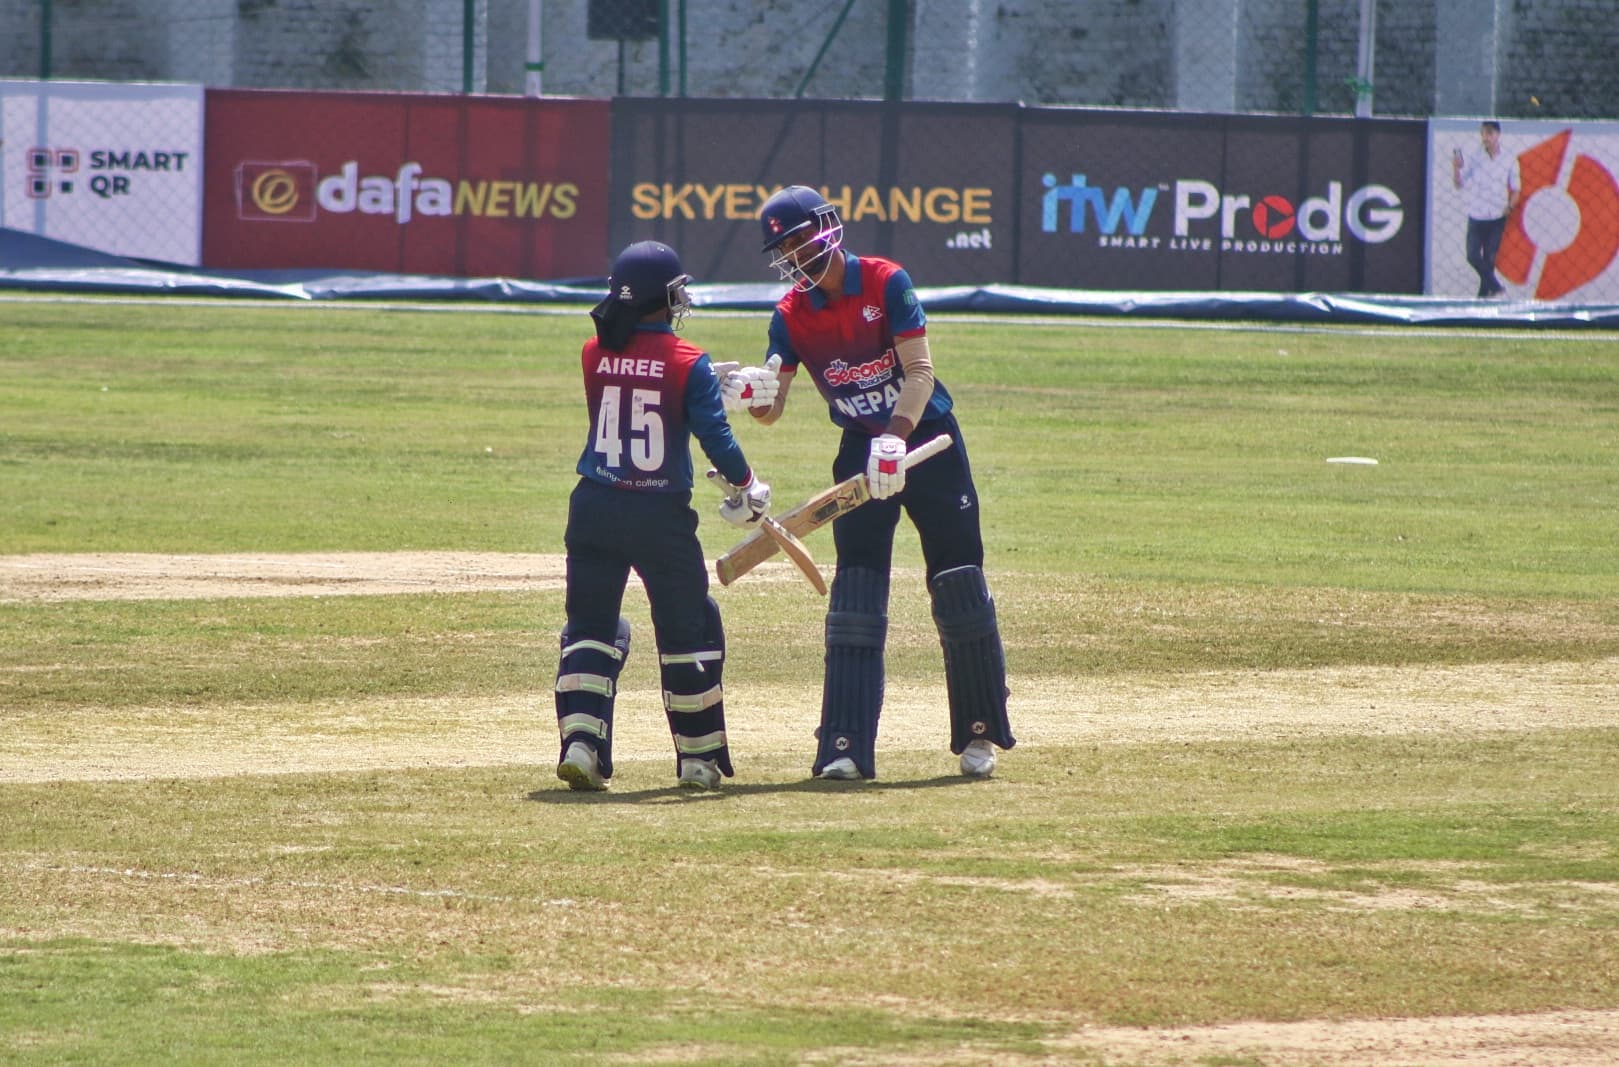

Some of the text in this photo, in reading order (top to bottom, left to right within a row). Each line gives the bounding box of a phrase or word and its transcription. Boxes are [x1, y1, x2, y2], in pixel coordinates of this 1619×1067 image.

[90, 151, 189, 171] SMART
[90, 175, 130, 198] QR
[632, 183, 992, 224] SKYEXHANGE
[1042, 173, 1158, 235] itw
[1099, 236, 1343, 255] SMART LIVE PRODUCTION
[596, 356, 665, 378] AIREE
[824, 349, 896, 387] Second
[834, 377, 905, 418] NEPA
[594, 385, 665, 472] 45
